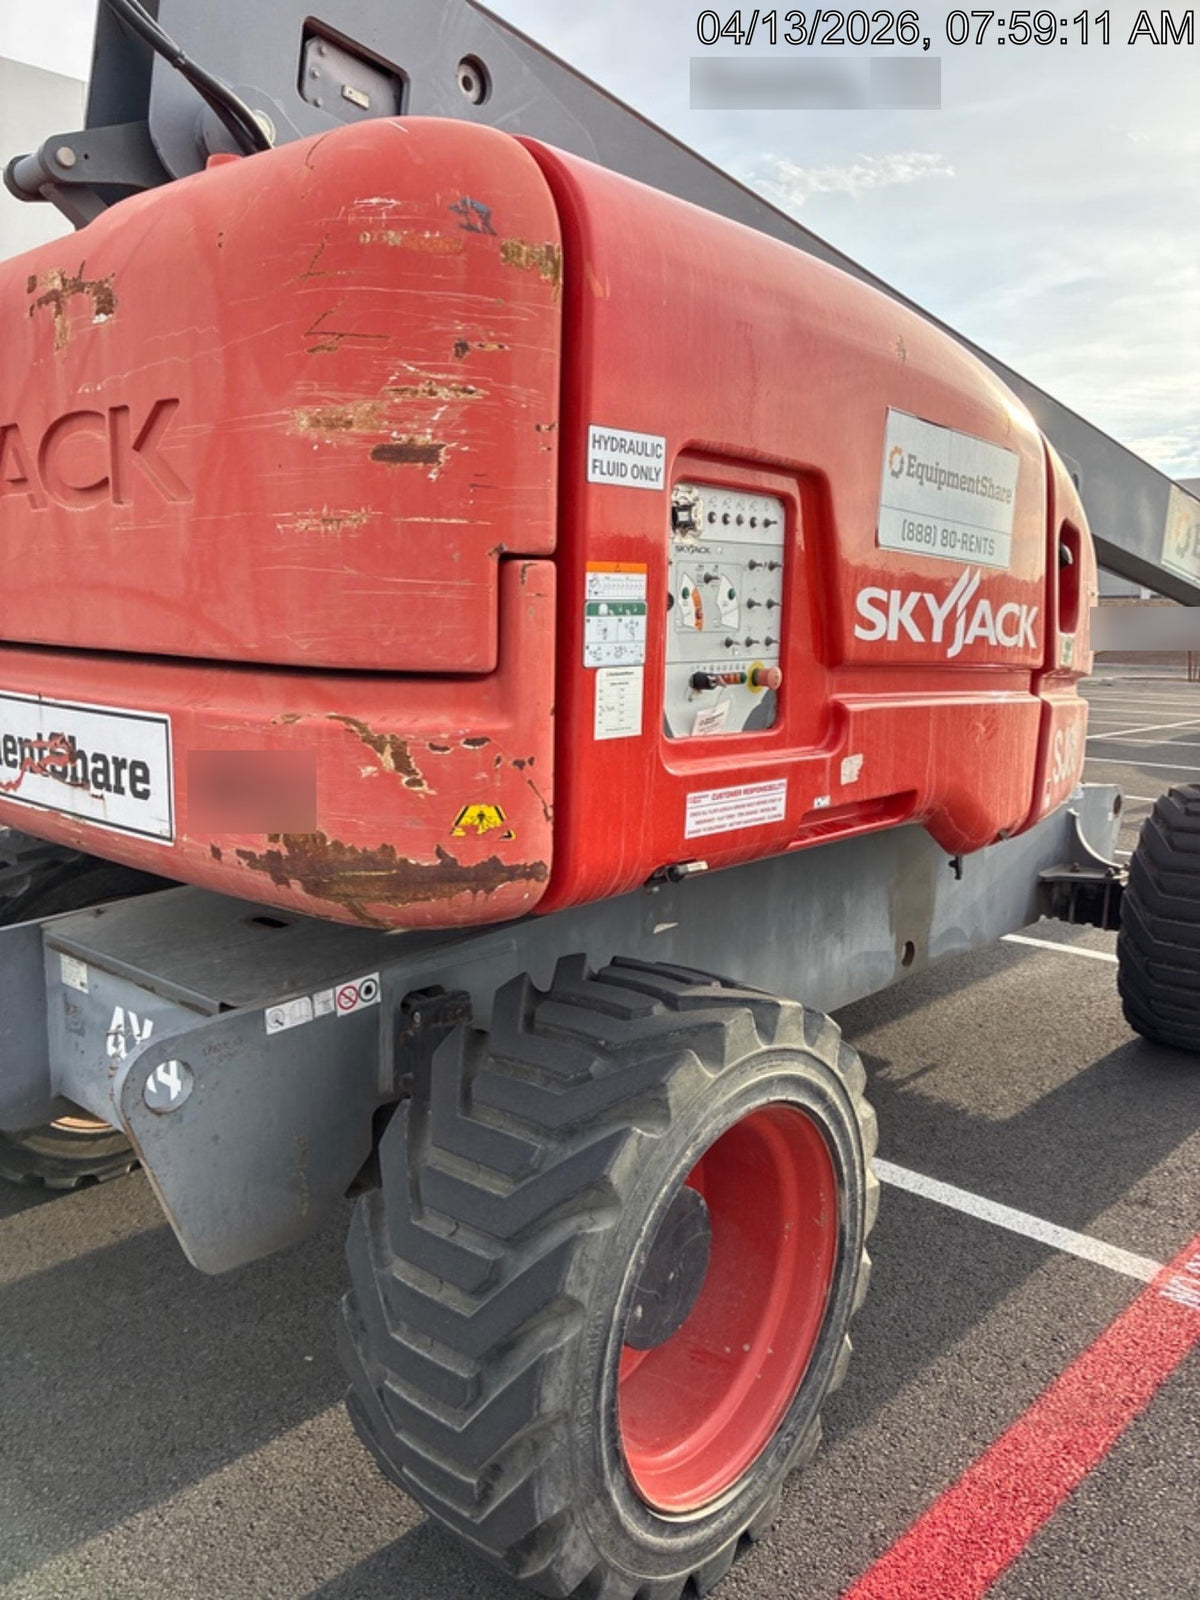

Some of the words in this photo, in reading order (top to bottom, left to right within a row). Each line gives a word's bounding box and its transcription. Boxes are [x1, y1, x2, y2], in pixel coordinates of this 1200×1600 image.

[591, 433, 663, 459] HYDRAULIC
[591, 458, 628, 478] FLUID
[630, 463, 662, 482] ONLY
[905, 453, 1013, 505] EquipmentShare
[901, 519, 938, 546] (888)
[940, 529, 995, 556] 80-RENTS
[854, 565, 1040, 659] SKYJACK
[0, 731, 151, 801] entShare
